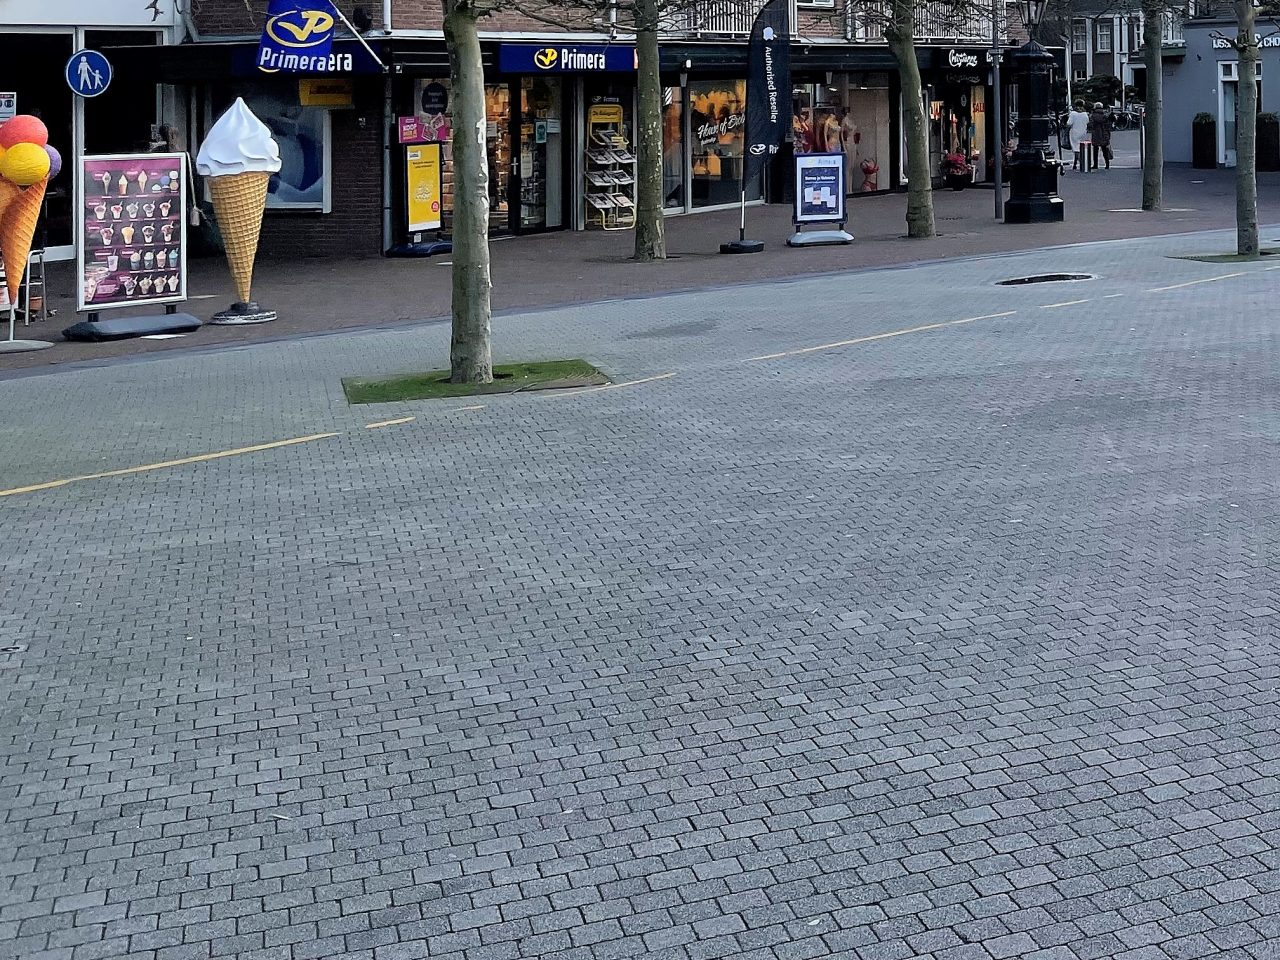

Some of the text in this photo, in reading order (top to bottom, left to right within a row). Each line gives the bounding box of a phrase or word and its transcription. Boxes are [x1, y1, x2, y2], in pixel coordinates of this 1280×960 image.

[260, 47, 327, 72] Primera
[561, 48, 606, 70] Primera
[765, 45, 779, 124] Authorised Reseller
